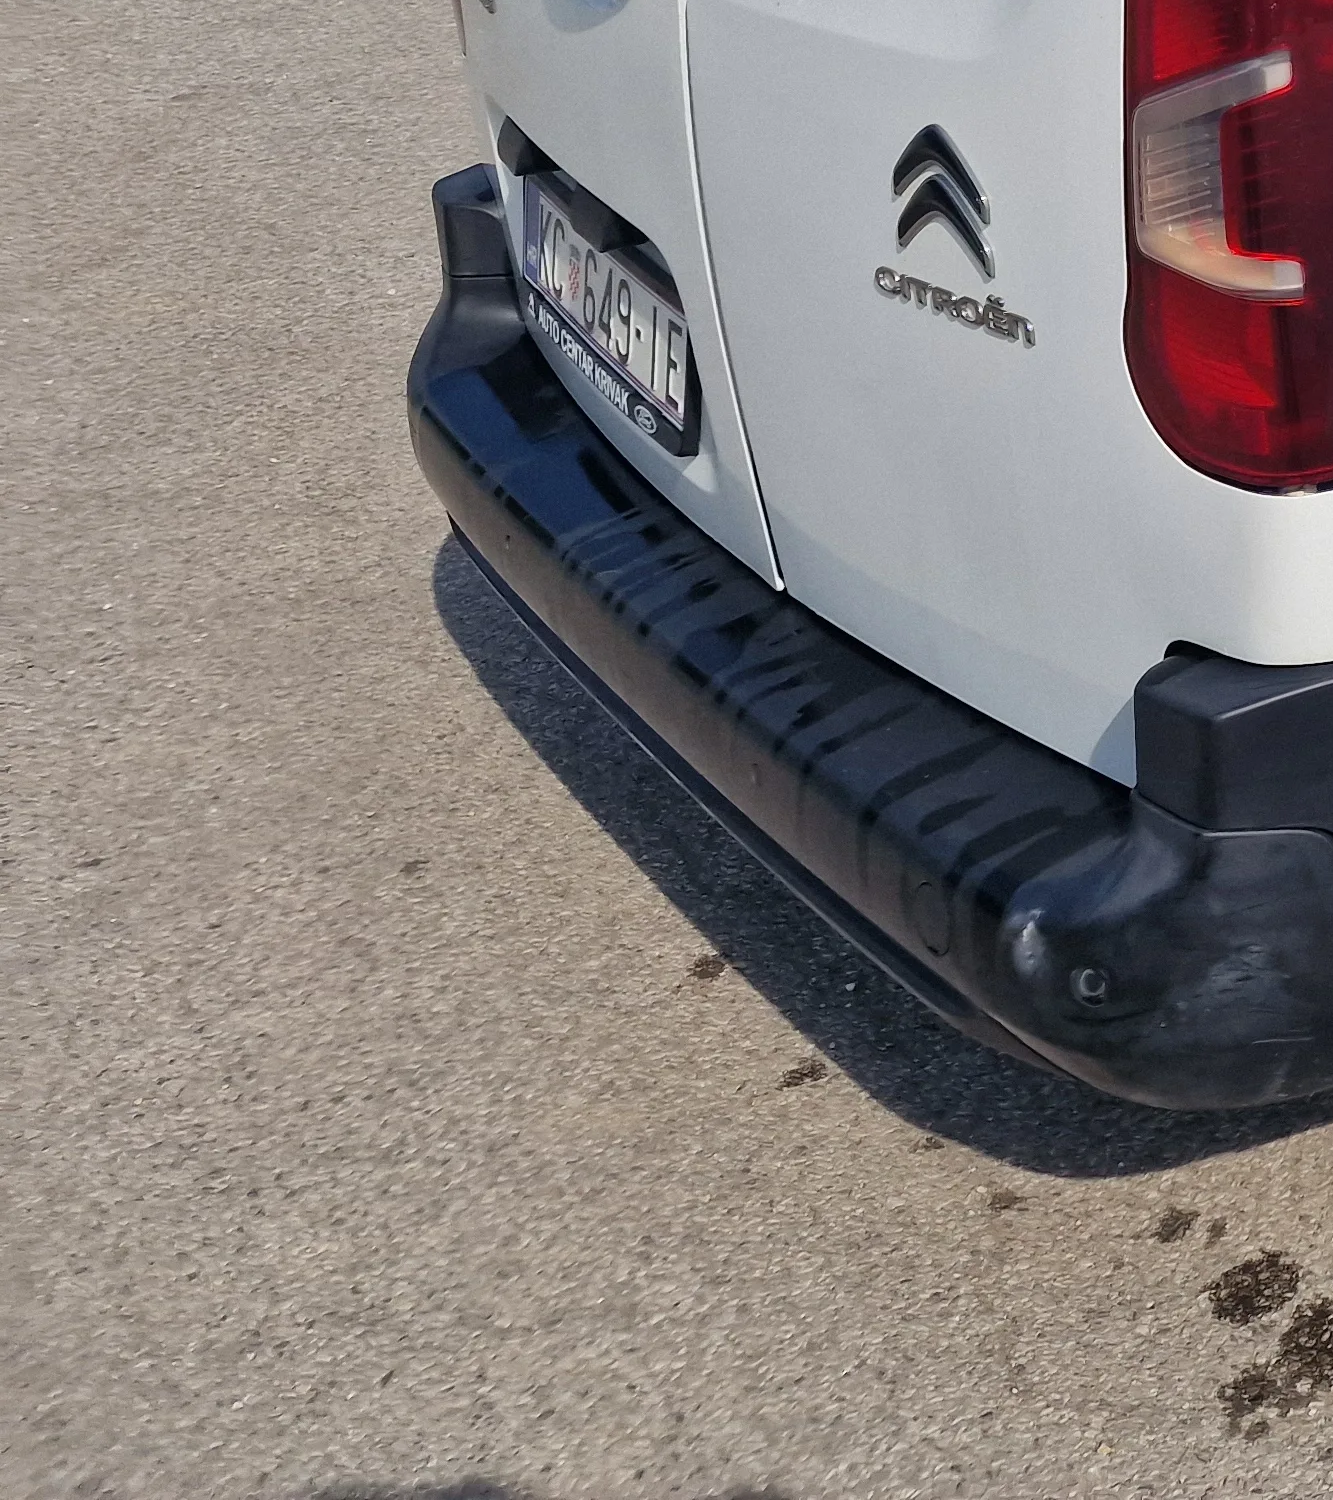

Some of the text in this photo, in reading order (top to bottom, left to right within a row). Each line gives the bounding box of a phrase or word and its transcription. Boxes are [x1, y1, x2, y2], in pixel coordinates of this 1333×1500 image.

[539, 203, 566, 301] KC
[538, 304, 630, 416] AUTO CENTAR KRIVAK
